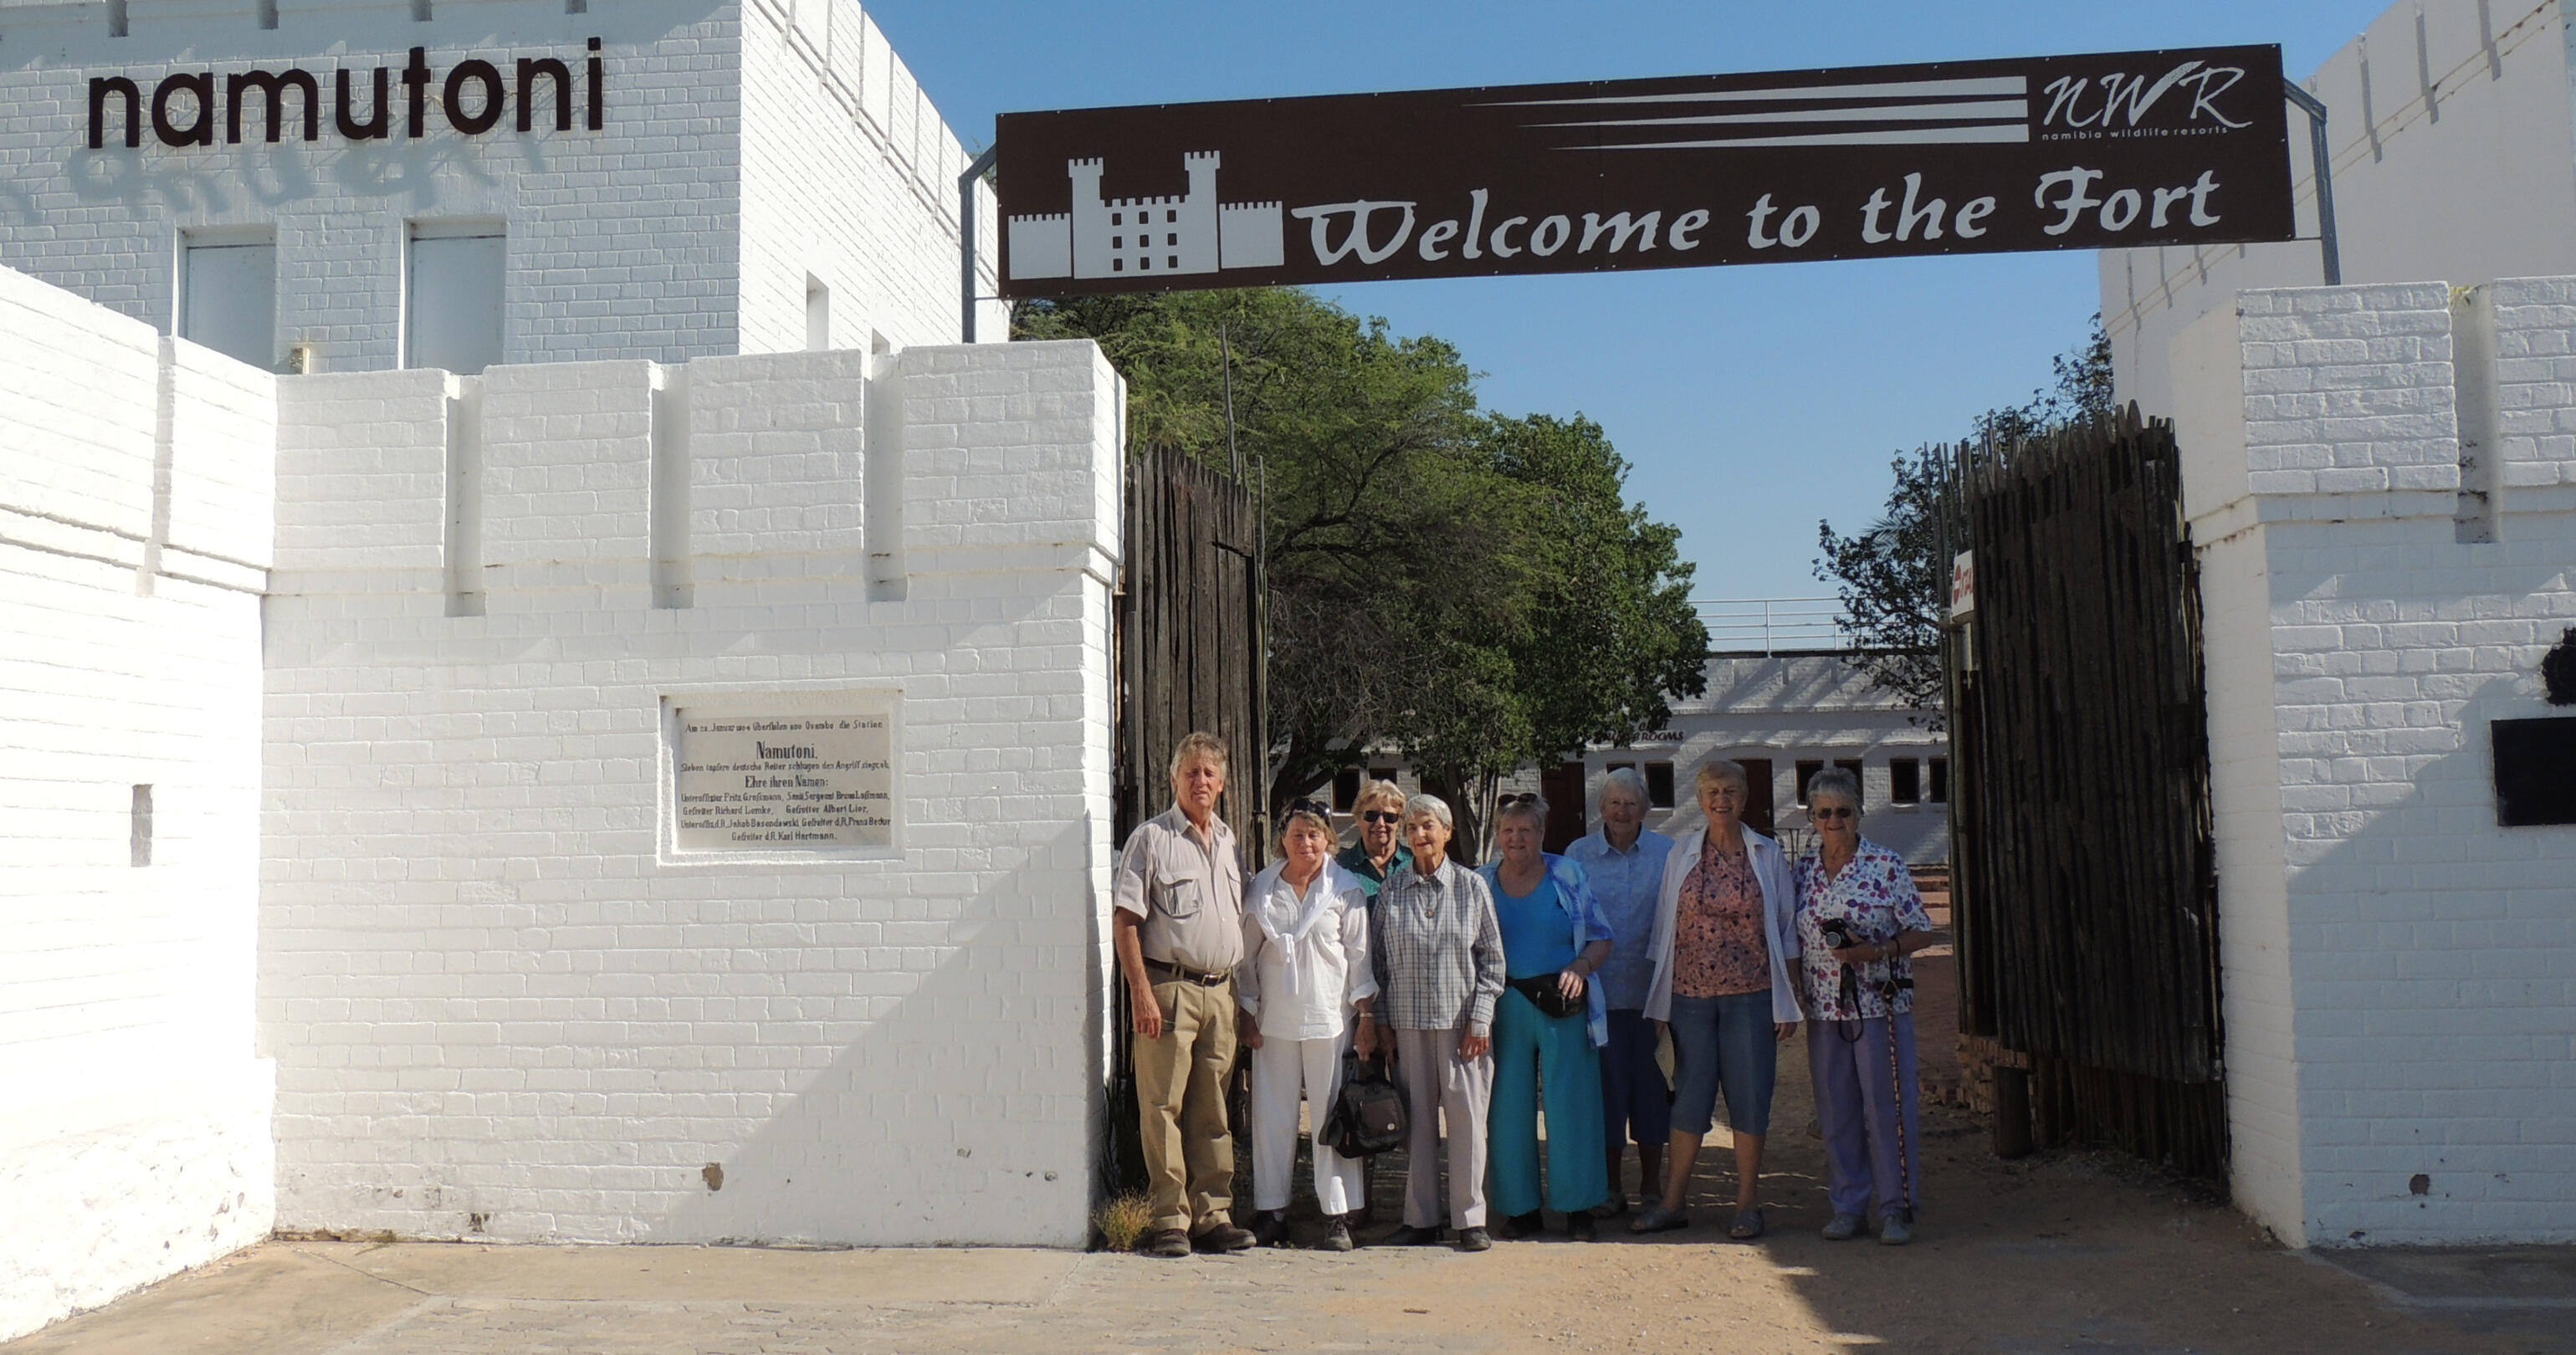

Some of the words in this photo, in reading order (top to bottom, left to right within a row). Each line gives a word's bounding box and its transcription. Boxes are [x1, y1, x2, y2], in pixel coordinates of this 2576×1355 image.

[89, 37, 603, 149] namutoni
[2043, 60, 2254, 128] NWR
[2041, 130, 2102, 141] namibia
[2110, 127, 2169, 138] wildlife
[2174, 125, 2228, 136] resorts
[1291, 187, 1709, 266] Welcome
[1745, 192, 1820, 249] to
[1859, 171, 1996, 244] the
[2035, 166, 2221, 236] Fort
[685, 723, 698, 733] Am
[805, 720, 834, 730] Ovambo
[839, 720, 851, 729] die
[853, 719, 883, 730] Station
[756, 740, 818, 759] Namutoni.
[822, 761, 835, 770] den
[745, 775, 767, 788] Ehre
[770, 775, 793, 788] ihren
[795, 775, 829, 787] Namen:
[715, 805, 743, 815] Richard
[823, 804, 847, 813] Albert
[731, 831, 763, 841] Gefreiter
[778, 831, 793, 841] Karl
